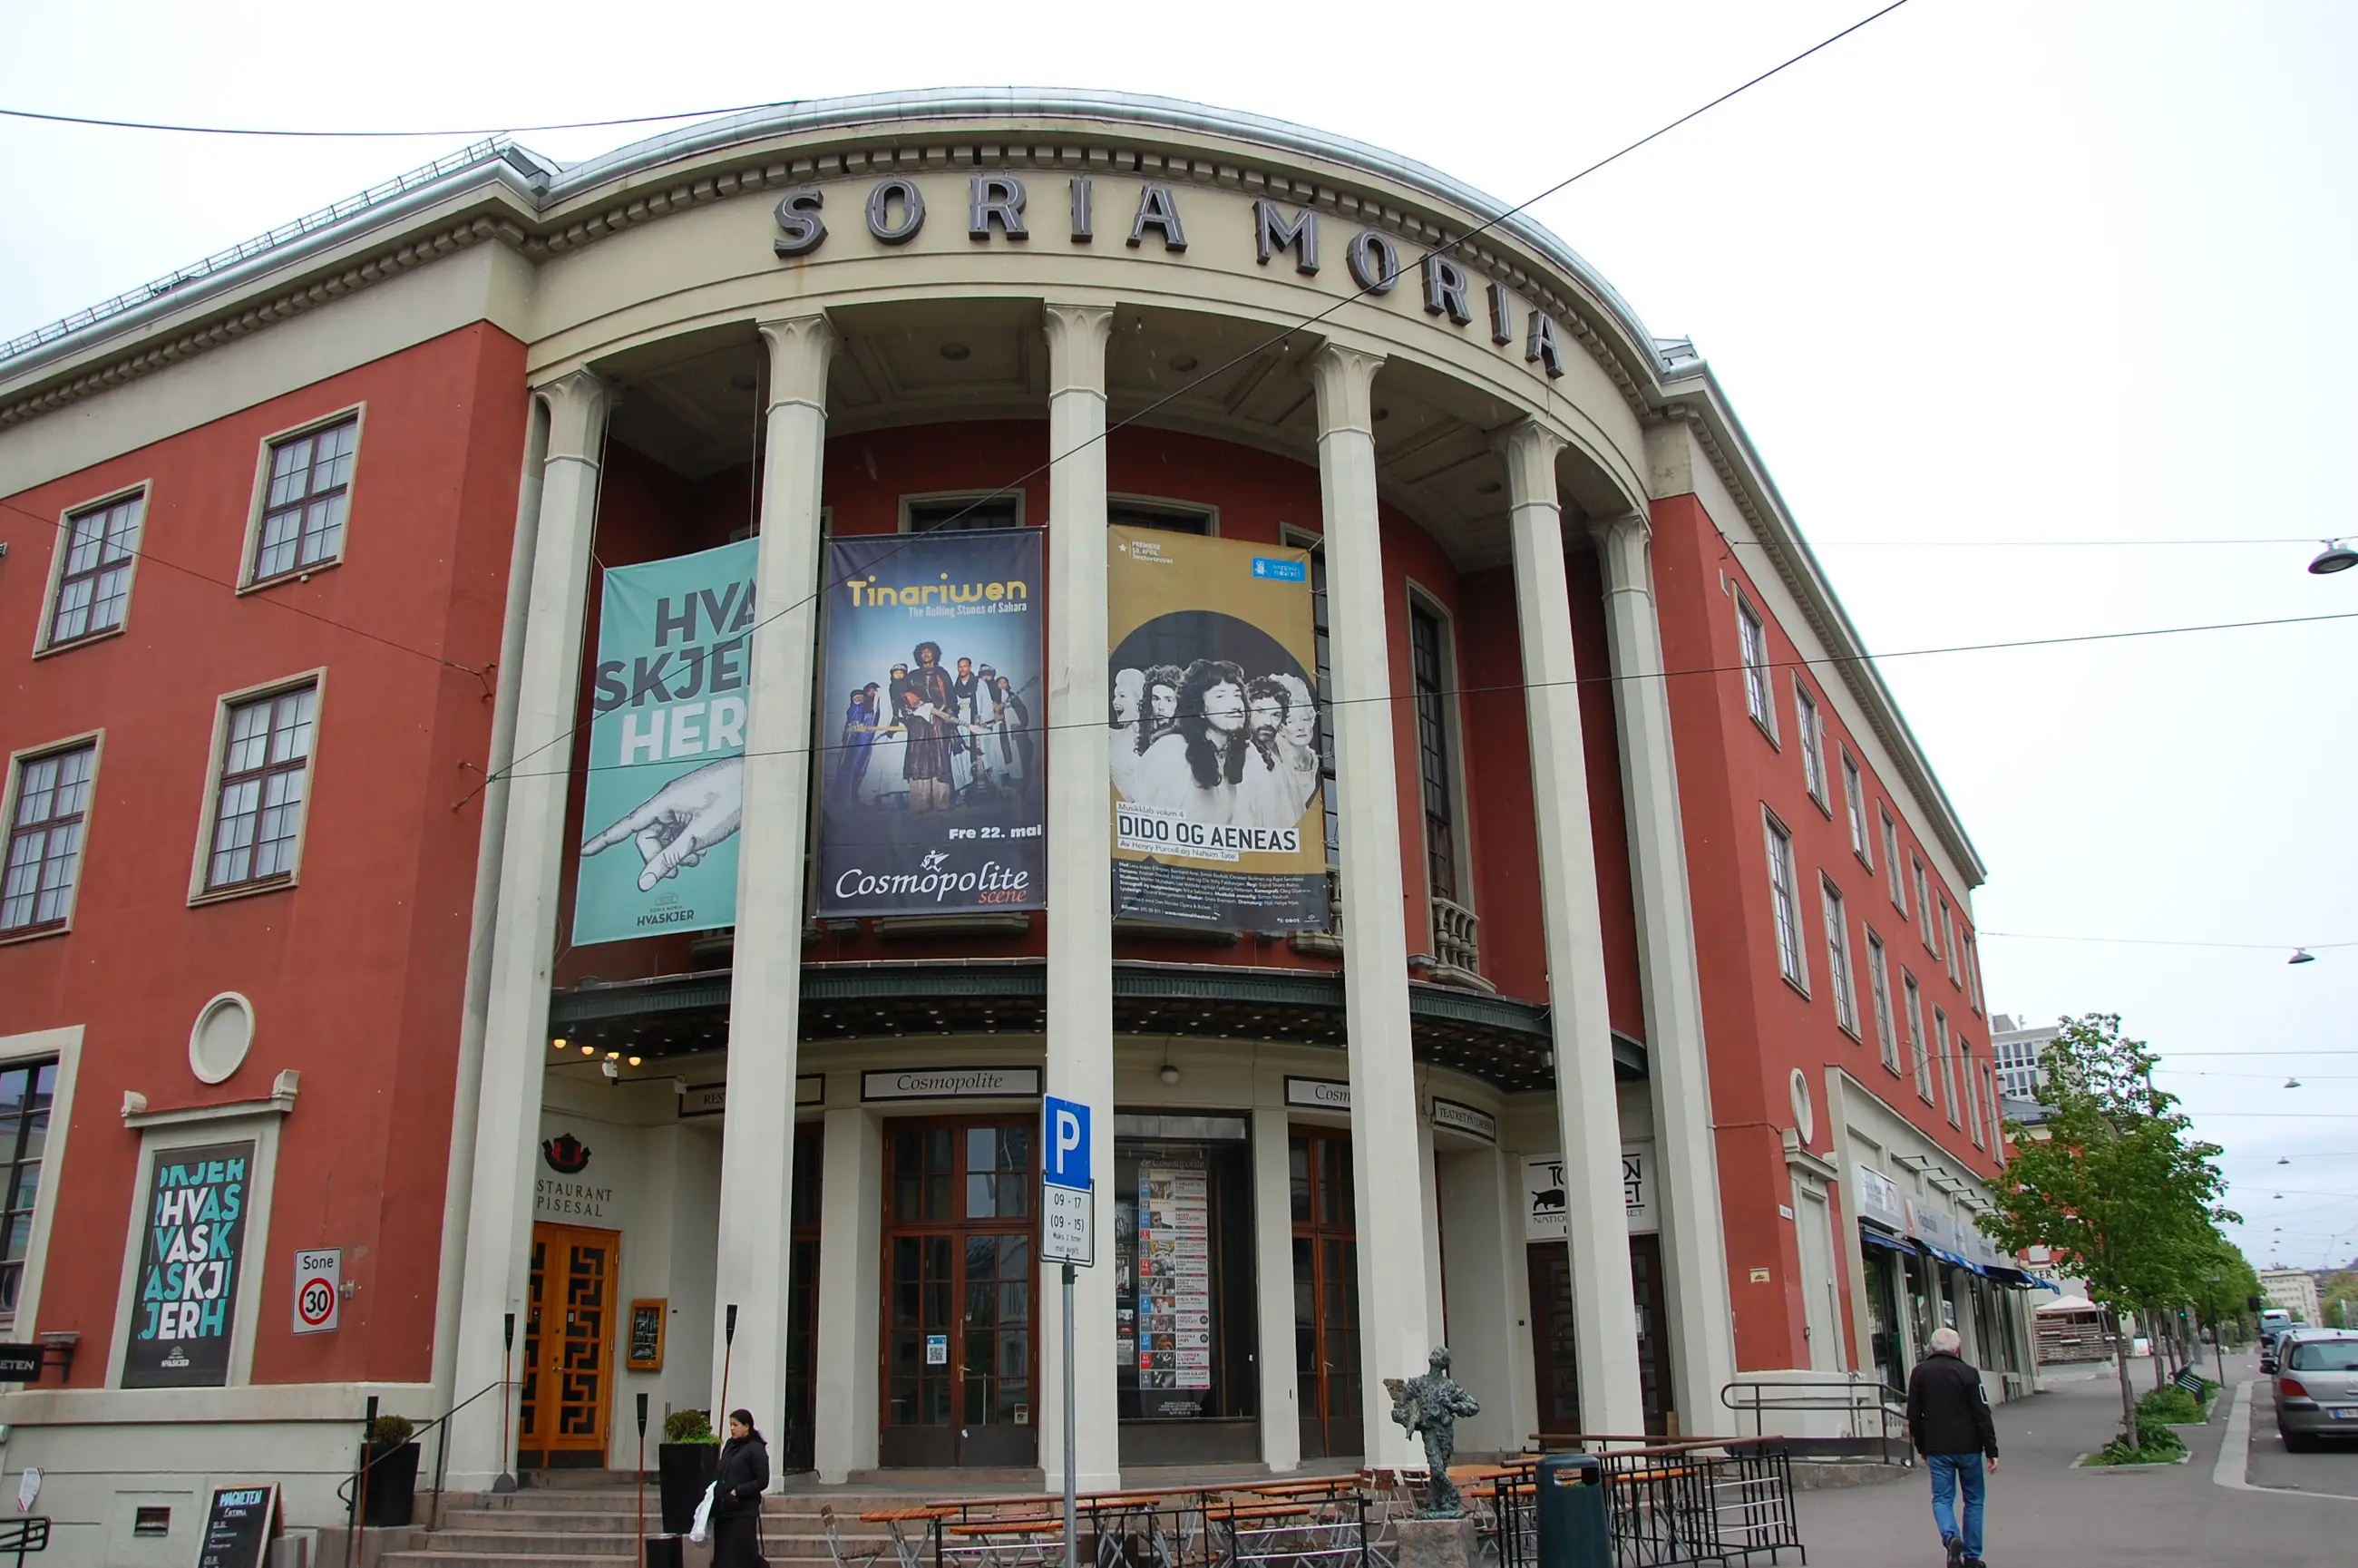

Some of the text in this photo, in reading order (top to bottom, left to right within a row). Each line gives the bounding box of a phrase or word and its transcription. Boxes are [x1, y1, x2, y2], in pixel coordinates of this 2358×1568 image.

[774, 174, 1566, 379] SORIA MORIA
[847, 572, 1028, 608] Tinariwen
[909, 601, 1028, 618] The Rolling Stones of Sahara
[594, 635, 753, 712] SKJE
[619, 695, 747, 767] HER
[1118, 803, 1154, 814] Musikklab
[1156, 808, 1177, 817] volum
[949, 823, 1042, 840] Fre 22. mai
[1119, 815, 1297, 851] DIDO OG AENEAS
[1131, 842, 1153, 852] Henry
[1156, 844, 1179, 853] Purcell
[1193, 849, 1218, 858] Nahum
[1220, 852, 1235, 860] Tate
[835, 862, 1028, 902] Cosmopolite
[979, 890, 1028, 904] scene
[637, 910, 695, 927] HVASKJER
[897, 1073, 1003, 1094] Cosmopolite
[1057, 1109, 1080, 1174] P
[1054, 1193, 1065, 1206] 09
[1074, 1196, 1082, 1209] 17
[1050, 1213, 1065, 1229] (09
[1074, 1218, 1085, 1233] 15)
[303, 1255, 334, 1271] Sone
[306, 1290, 328, 1313] 30
